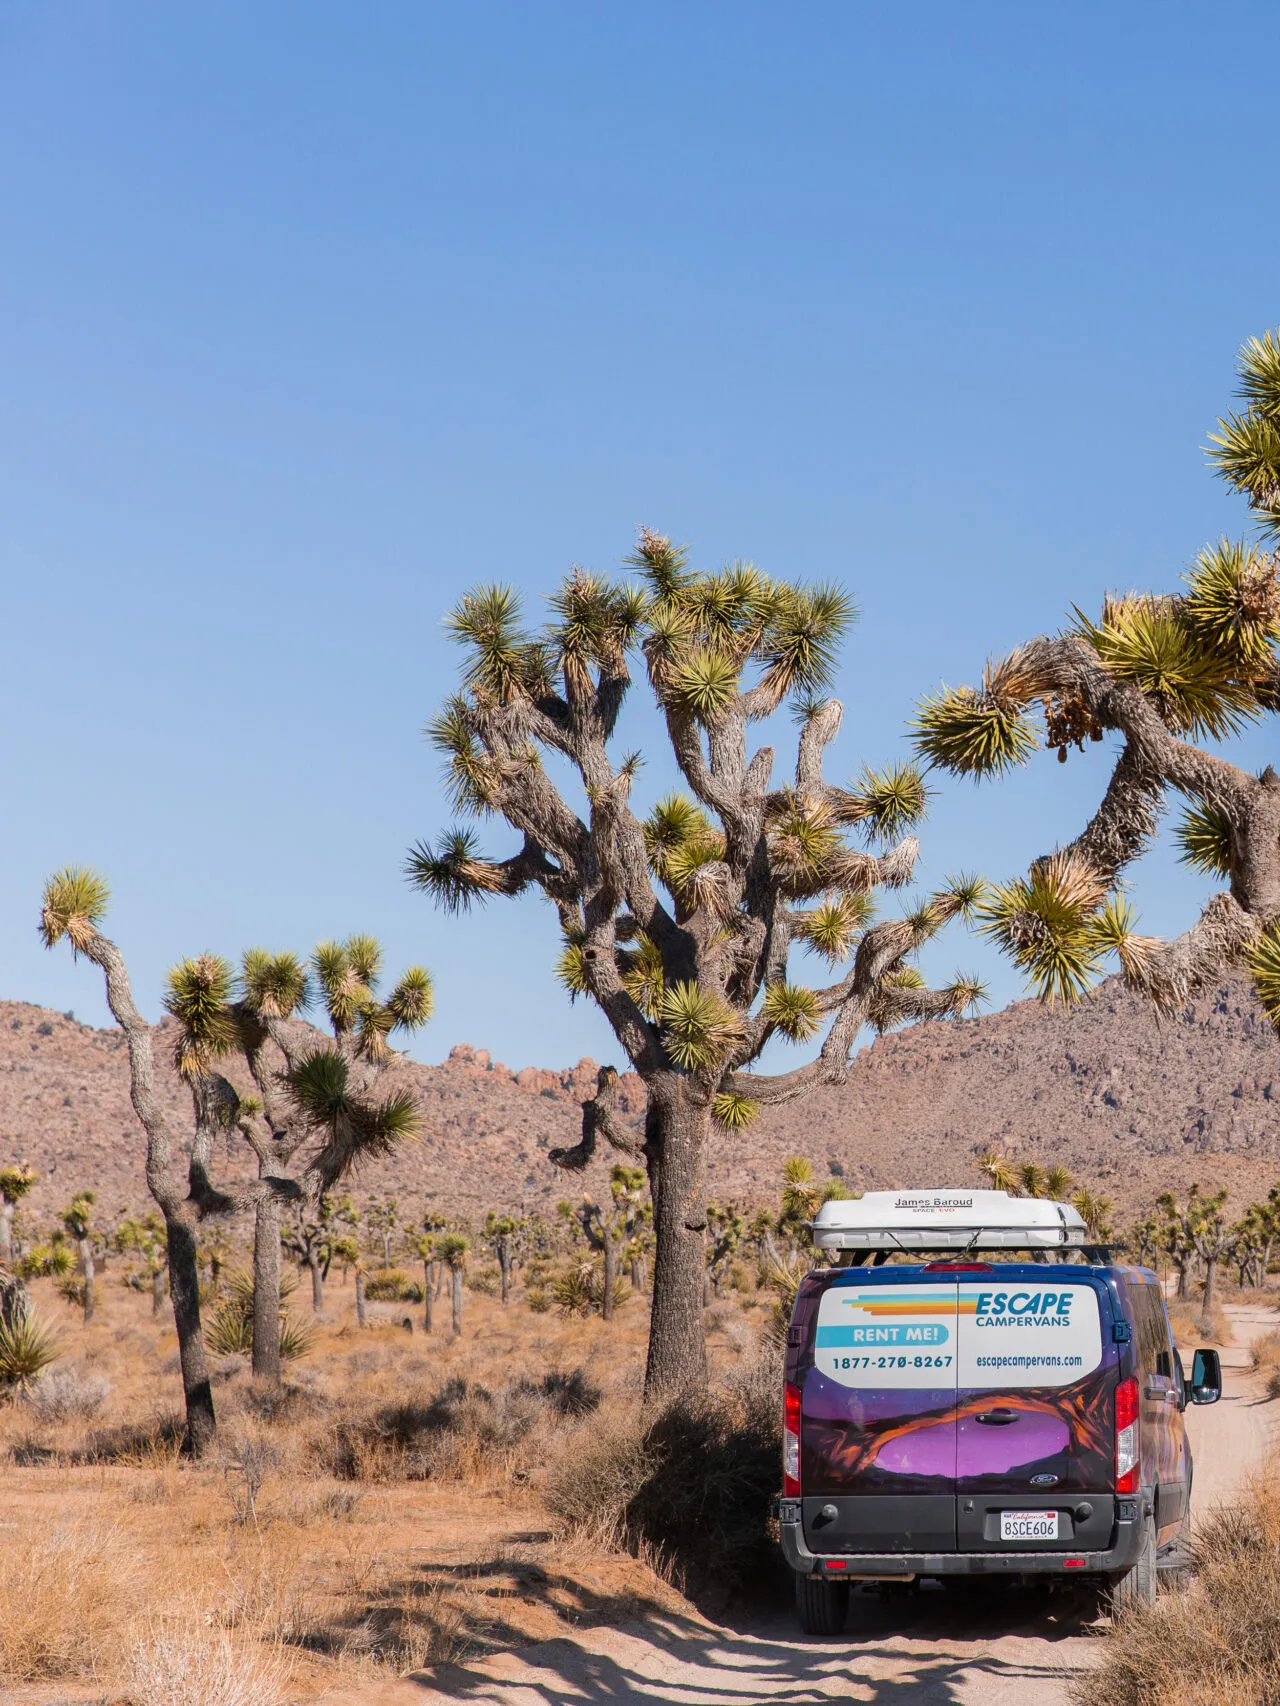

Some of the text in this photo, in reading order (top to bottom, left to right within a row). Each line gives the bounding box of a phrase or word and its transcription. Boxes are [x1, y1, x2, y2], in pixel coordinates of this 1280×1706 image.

[894, 1198, 973, 1206] James Baroud
[975, 1292, 1074, 1315] ESCAPE
[975, 1316, 1071, 1327] CAMPERVANS
[853, 1327, 938, 1342] RENT ME!
[833, 1356, 953, 1369] 1877-270-8267
[976, 1356, 1082, 1369] escapecampervans.com
[1004, 1521, 1054, 1536] 8SCE606
